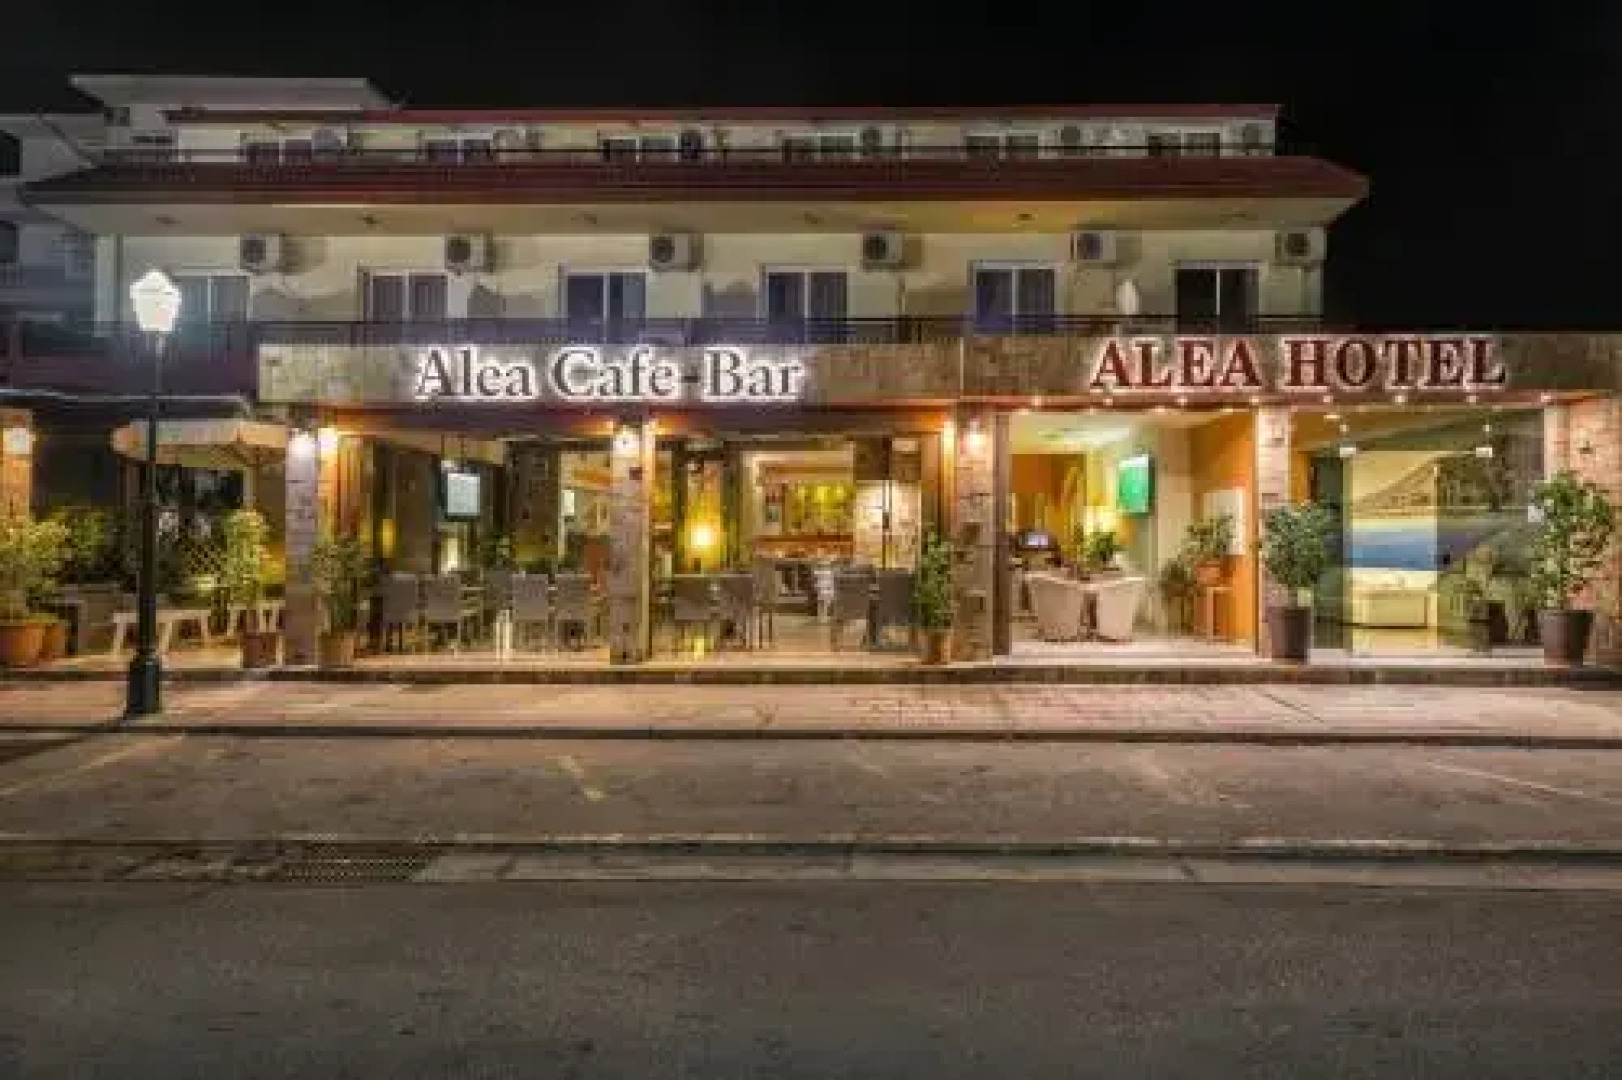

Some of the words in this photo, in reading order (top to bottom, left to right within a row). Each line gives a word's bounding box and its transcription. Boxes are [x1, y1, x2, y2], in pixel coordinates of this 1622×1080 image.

[414, 346, 536, 399] Alea
[1090, 338, 1263, 388] ALEA
[1282, 337, 1506, 388] HOTEL
